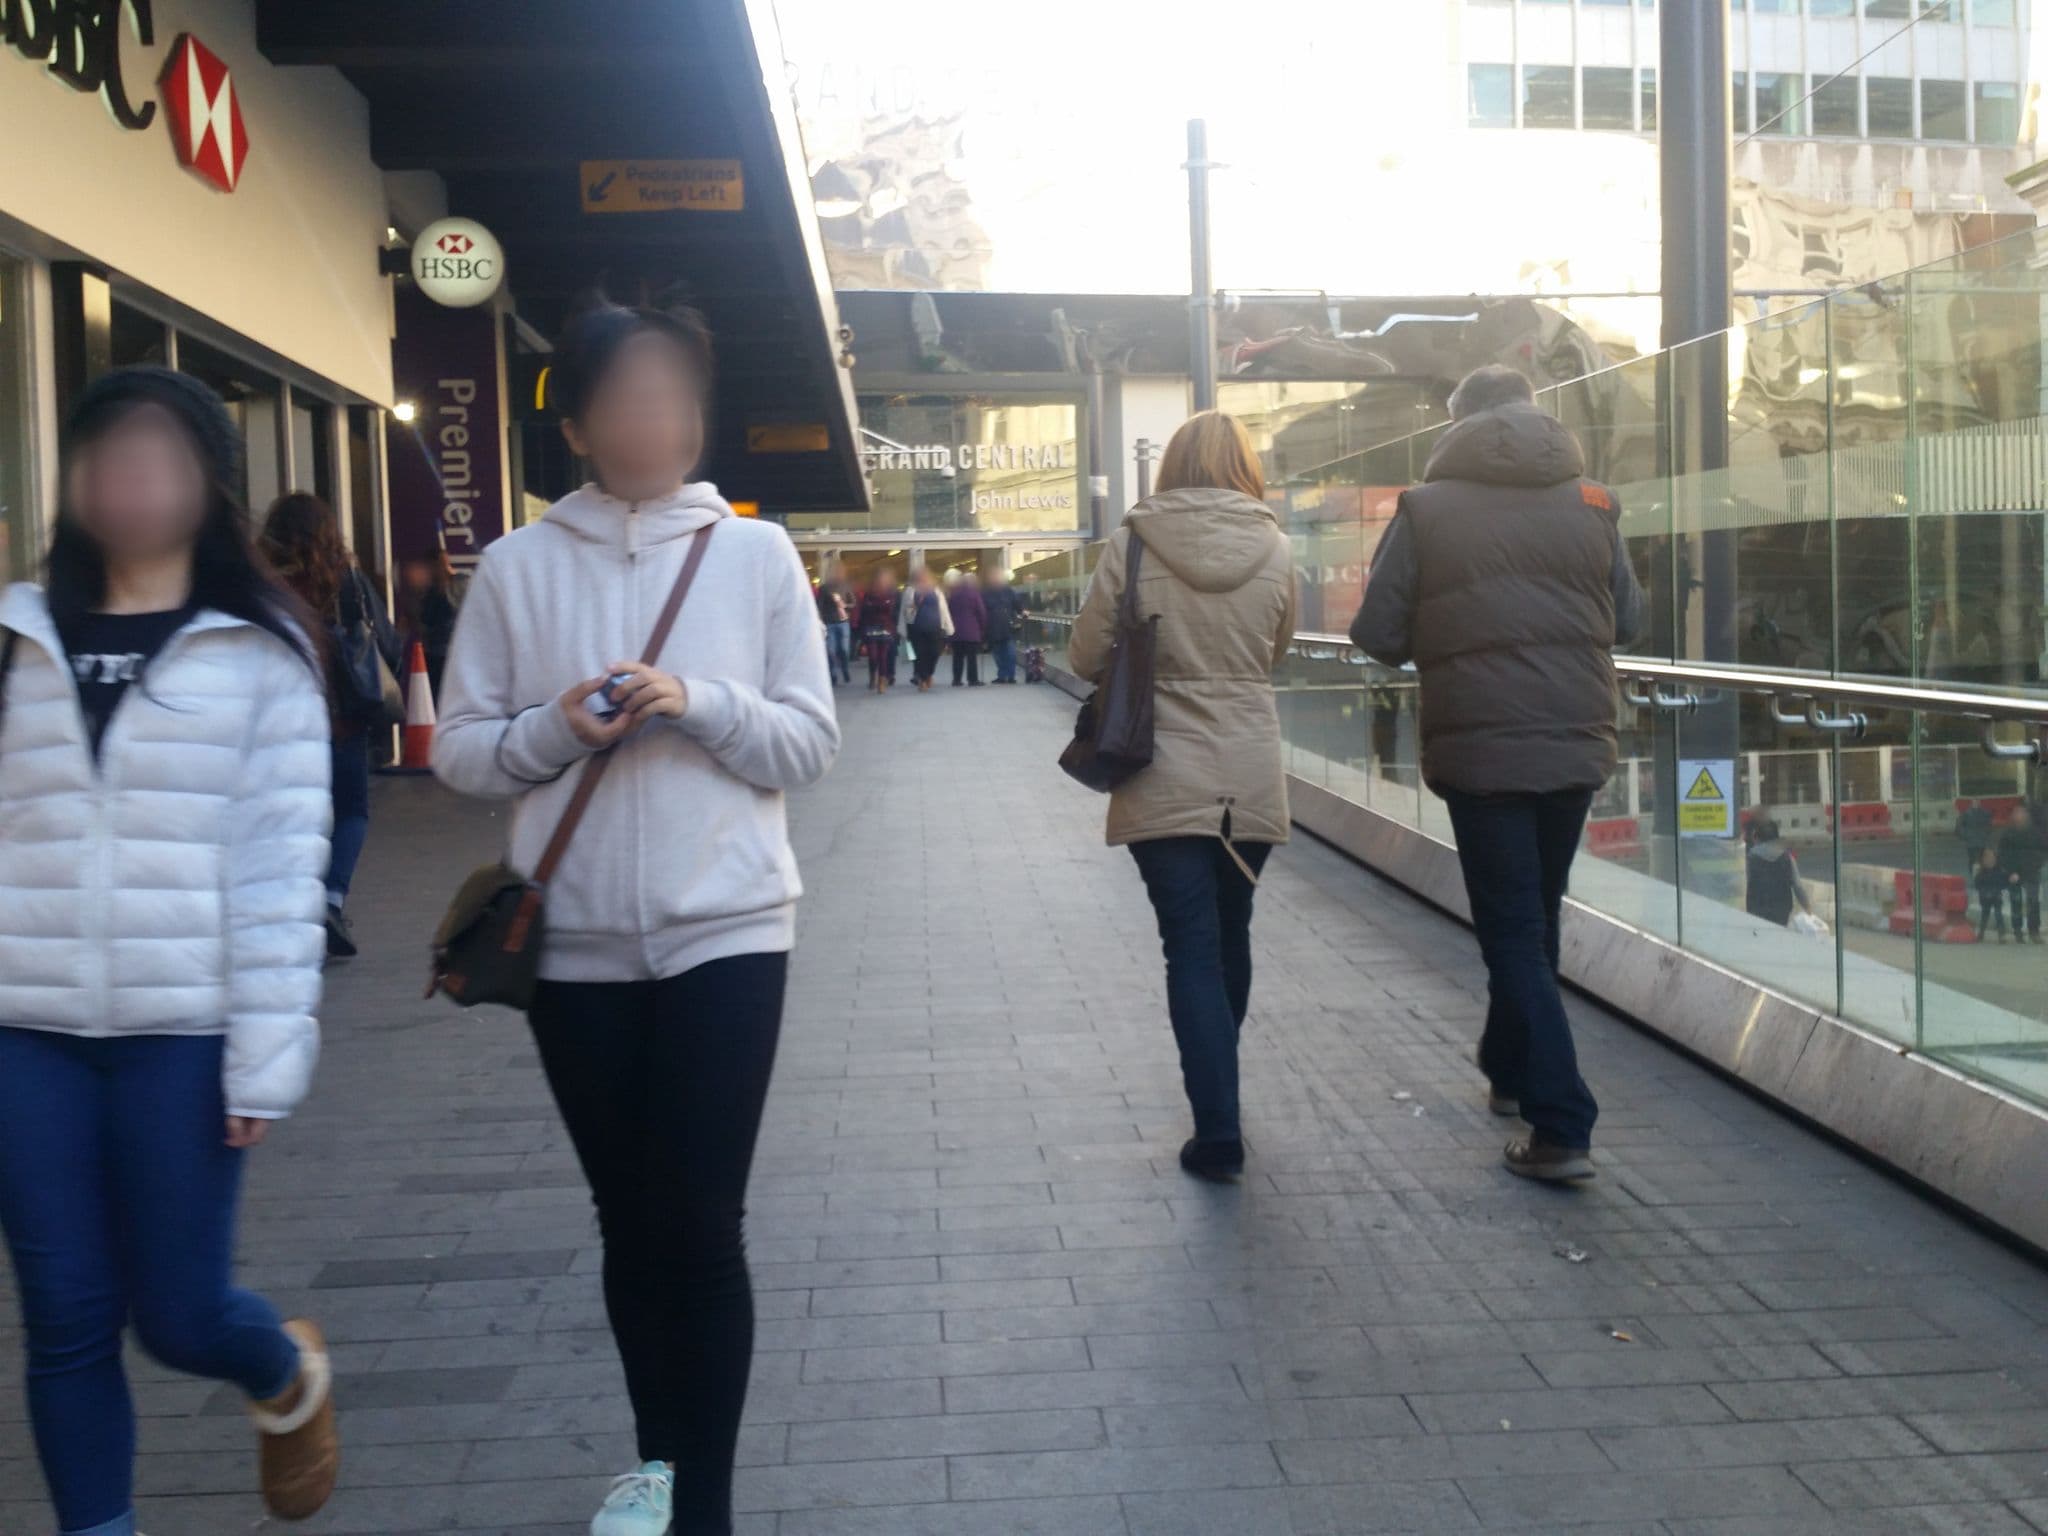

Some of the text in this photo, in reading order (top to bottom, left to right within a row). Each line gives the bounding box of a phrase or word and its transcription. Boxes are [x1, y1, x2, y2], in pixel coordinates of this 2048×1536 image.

[0, 0, 156, 130] BC
[421, 258, 493, 281] HSBC
[437, 377, 481, 546] Premier
[959, 444, 1073, 470] CENTRAL
[968, 489, 1073, 514] John Lewis
